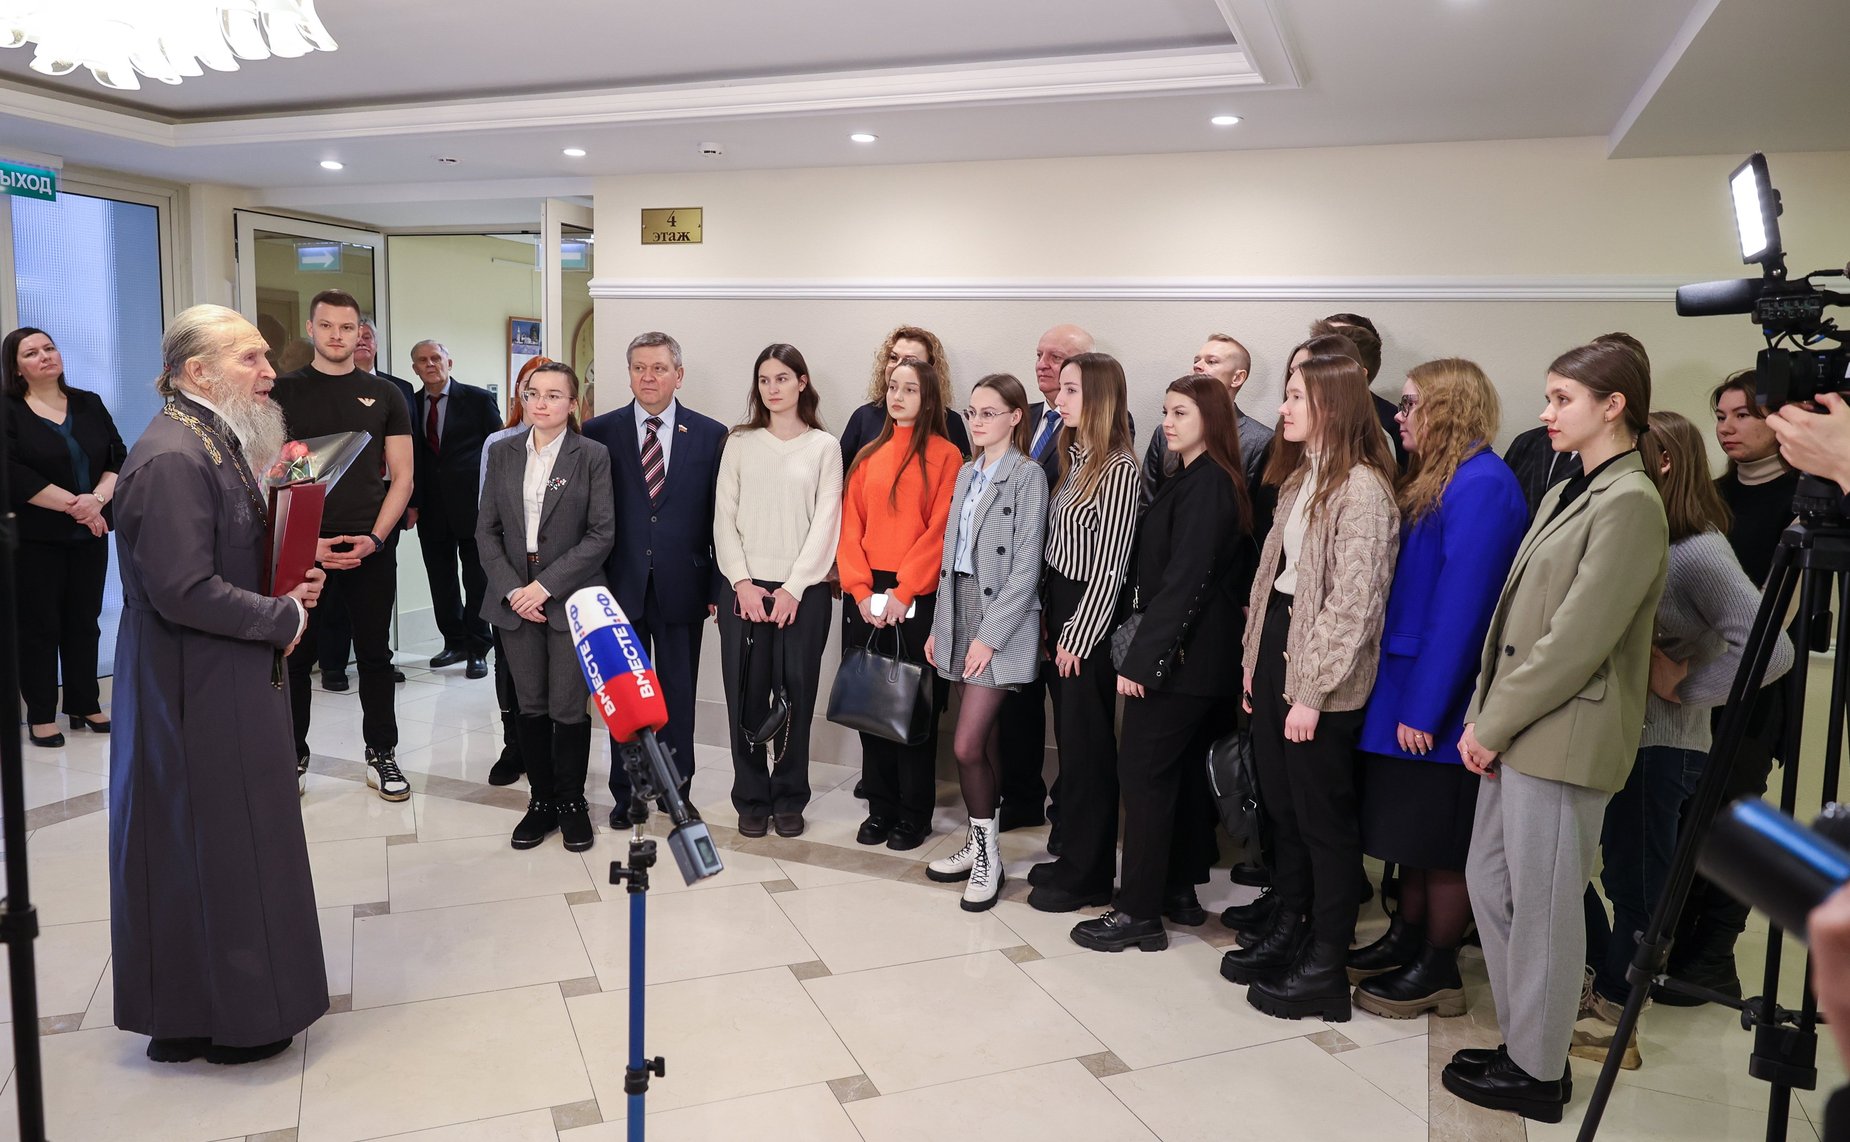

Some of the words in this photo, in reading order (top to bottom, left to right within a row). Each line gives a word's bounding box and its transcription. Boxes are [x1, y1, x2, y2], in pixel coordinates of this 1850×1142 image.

[0, 169, 52, 195] ЫХОД
[666, 210, 677, 227] 4
[652, 231, 691, 242] этаж
